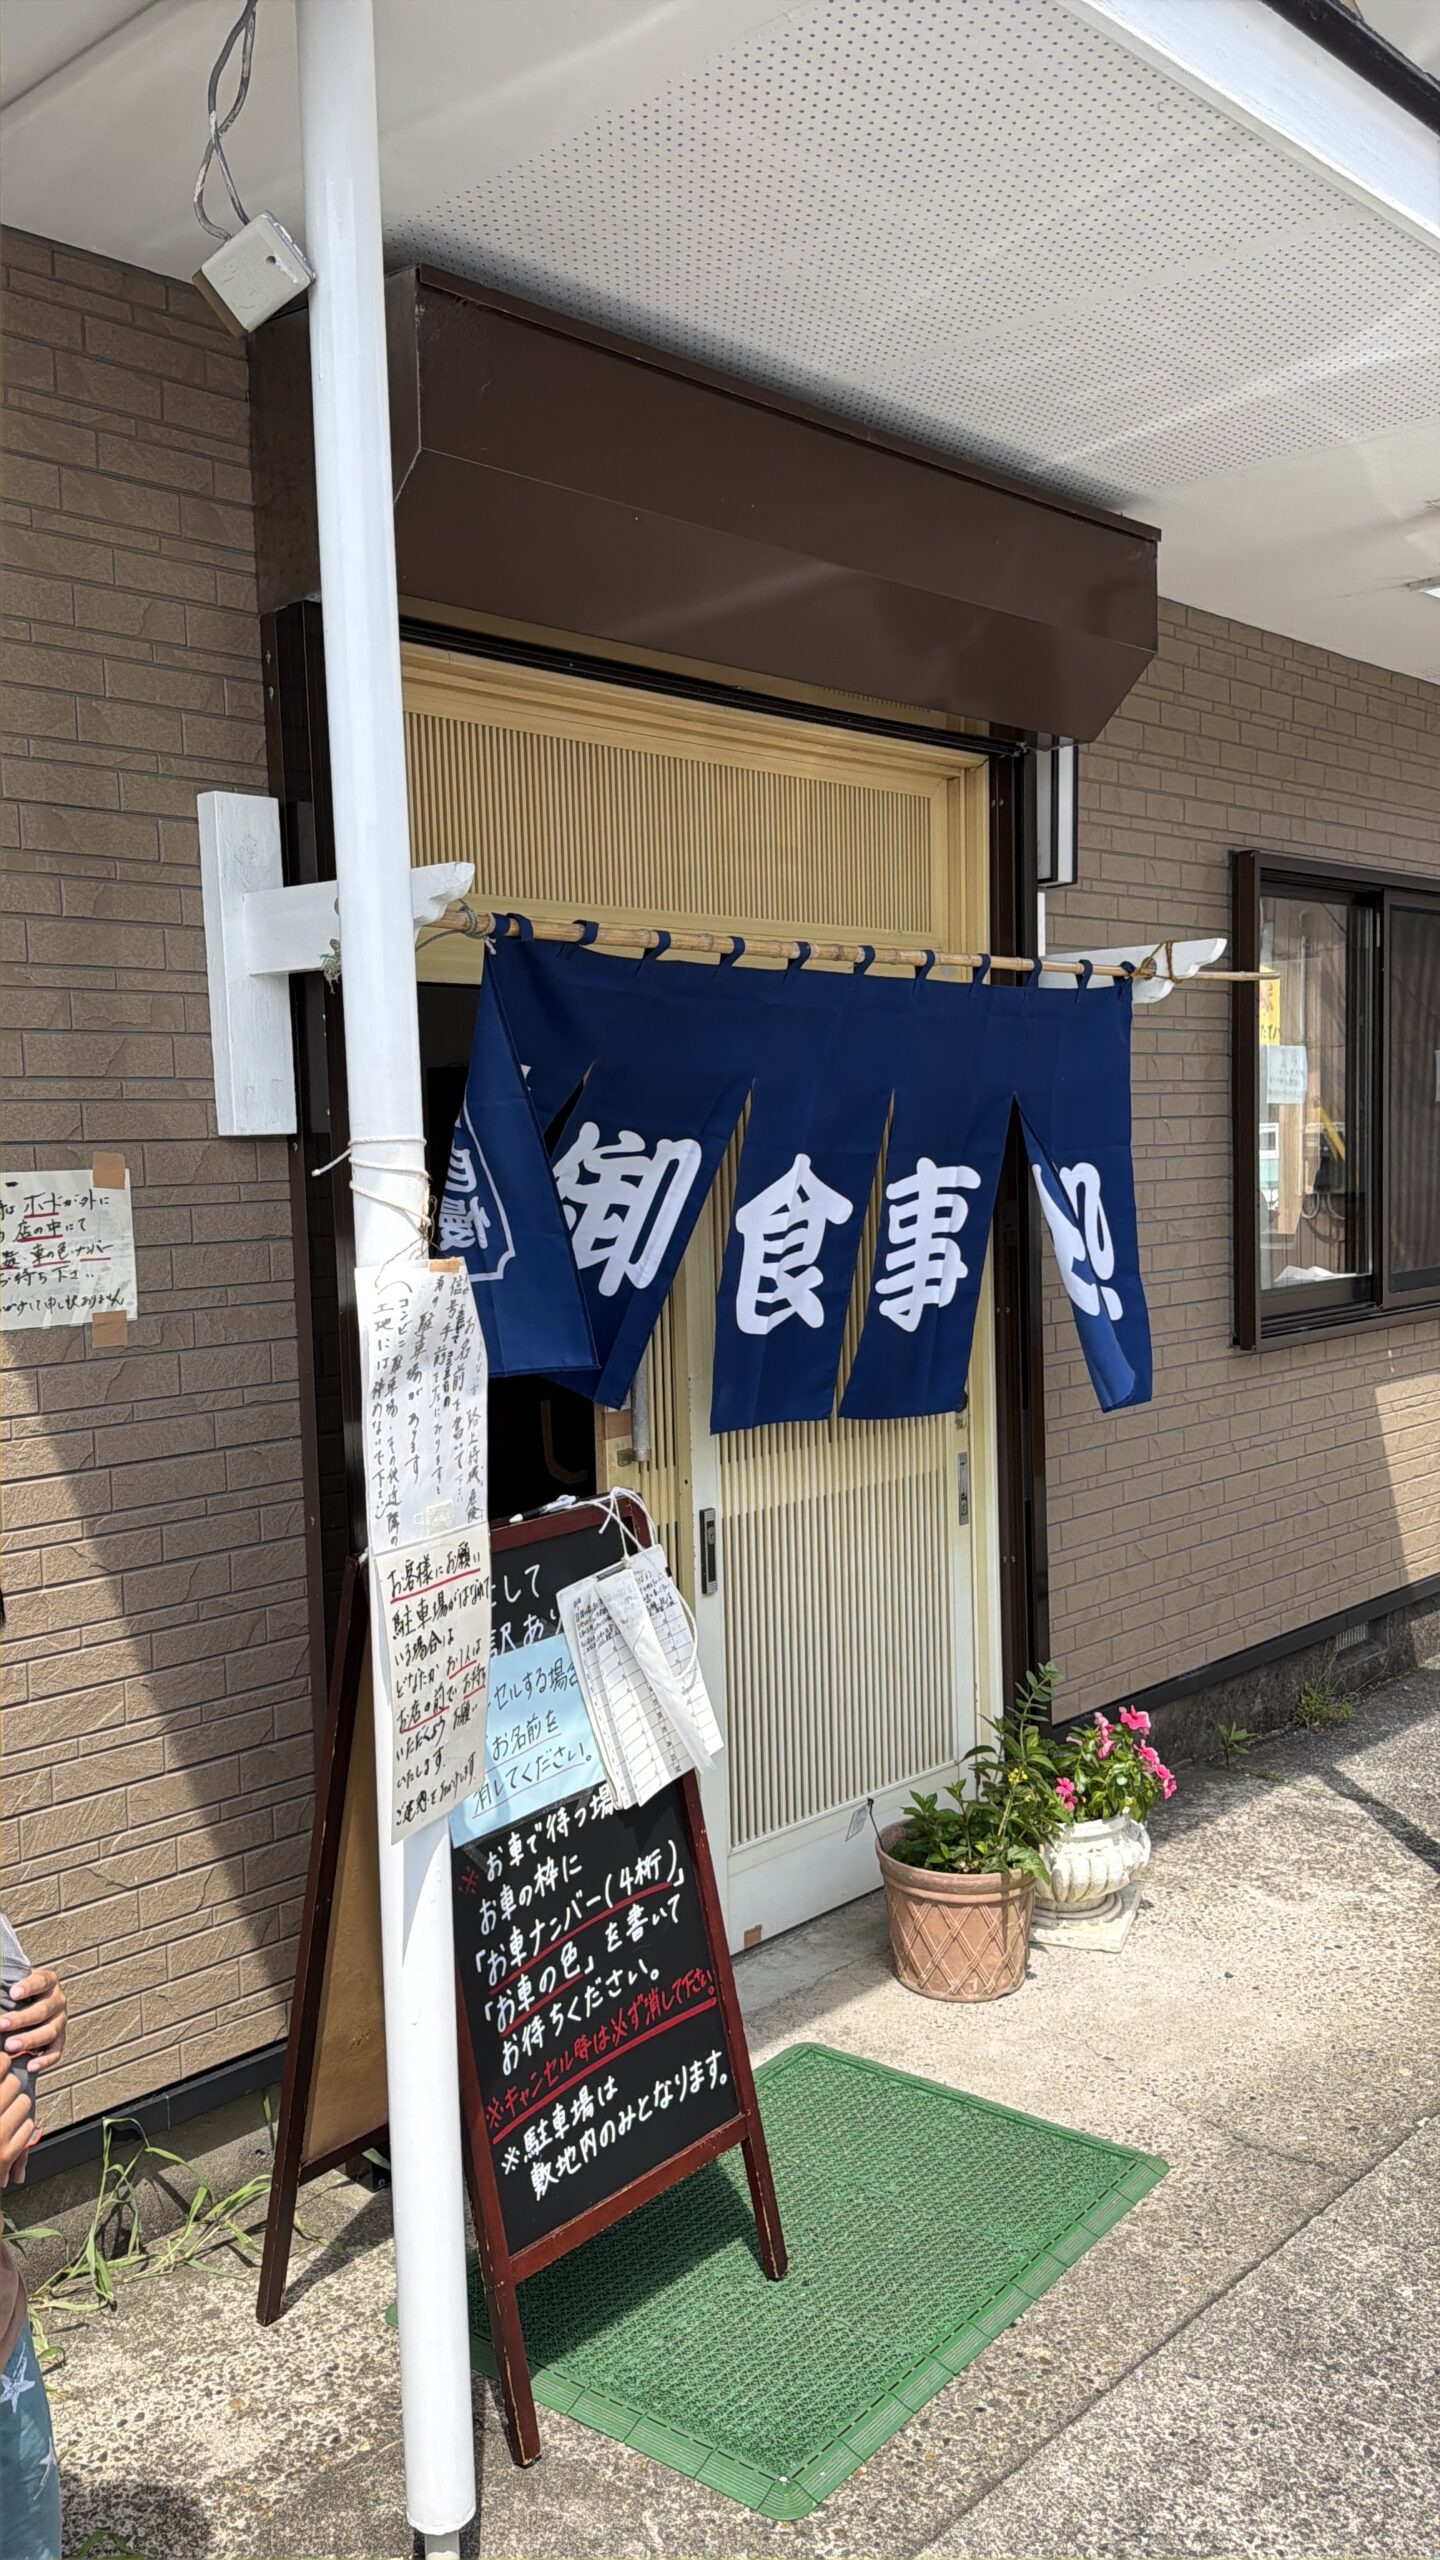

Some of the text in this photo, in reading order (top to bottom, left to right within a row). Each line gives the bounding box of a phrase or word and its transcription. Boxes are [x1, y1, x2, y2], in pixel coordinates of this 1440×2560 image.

[480, 1854, 582, 1935] お車の枠に
